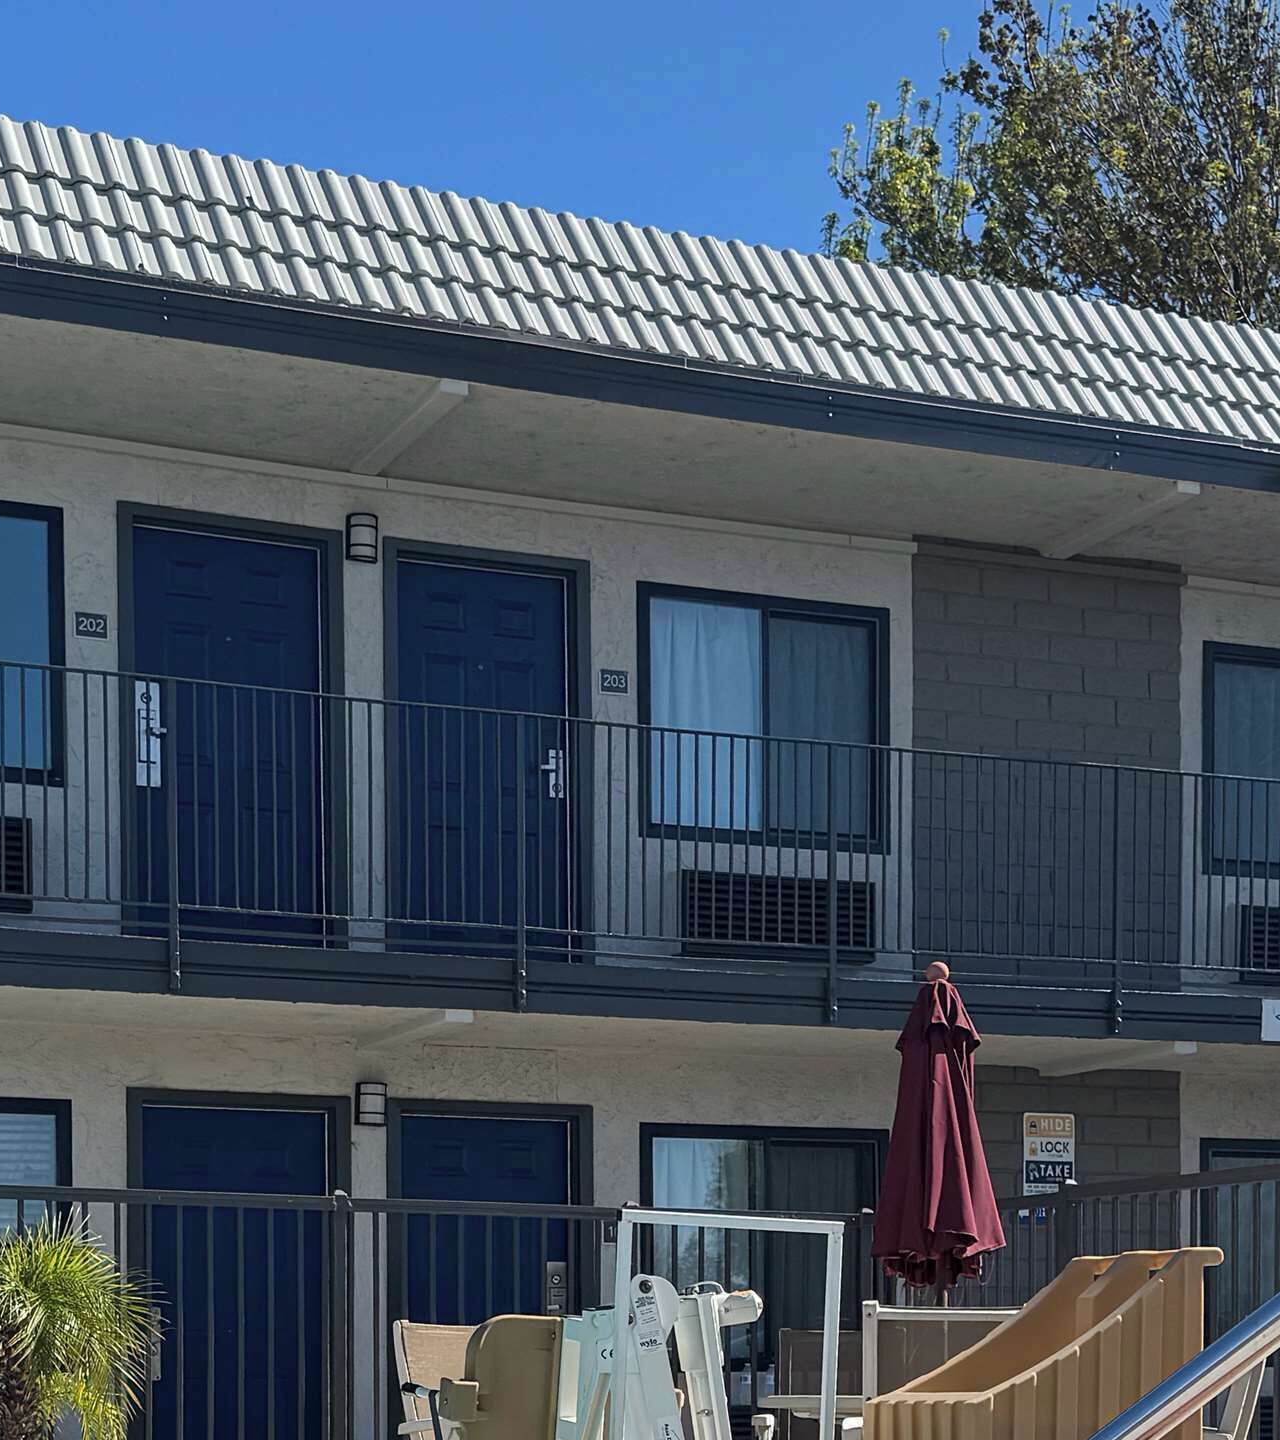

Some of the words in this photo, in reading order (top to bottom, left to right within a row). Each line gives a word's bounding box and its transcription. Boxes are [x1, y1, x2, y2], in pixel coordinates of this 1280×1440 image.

[78, 617, 105, 633] 202
[603, 674, 626, 688] 203
[1040, 1118, 1072, 1131] HIDE
[1040, 1141, 1070, 1154] LOCK
[1040, 1164, 1070, 1178] TAKE
